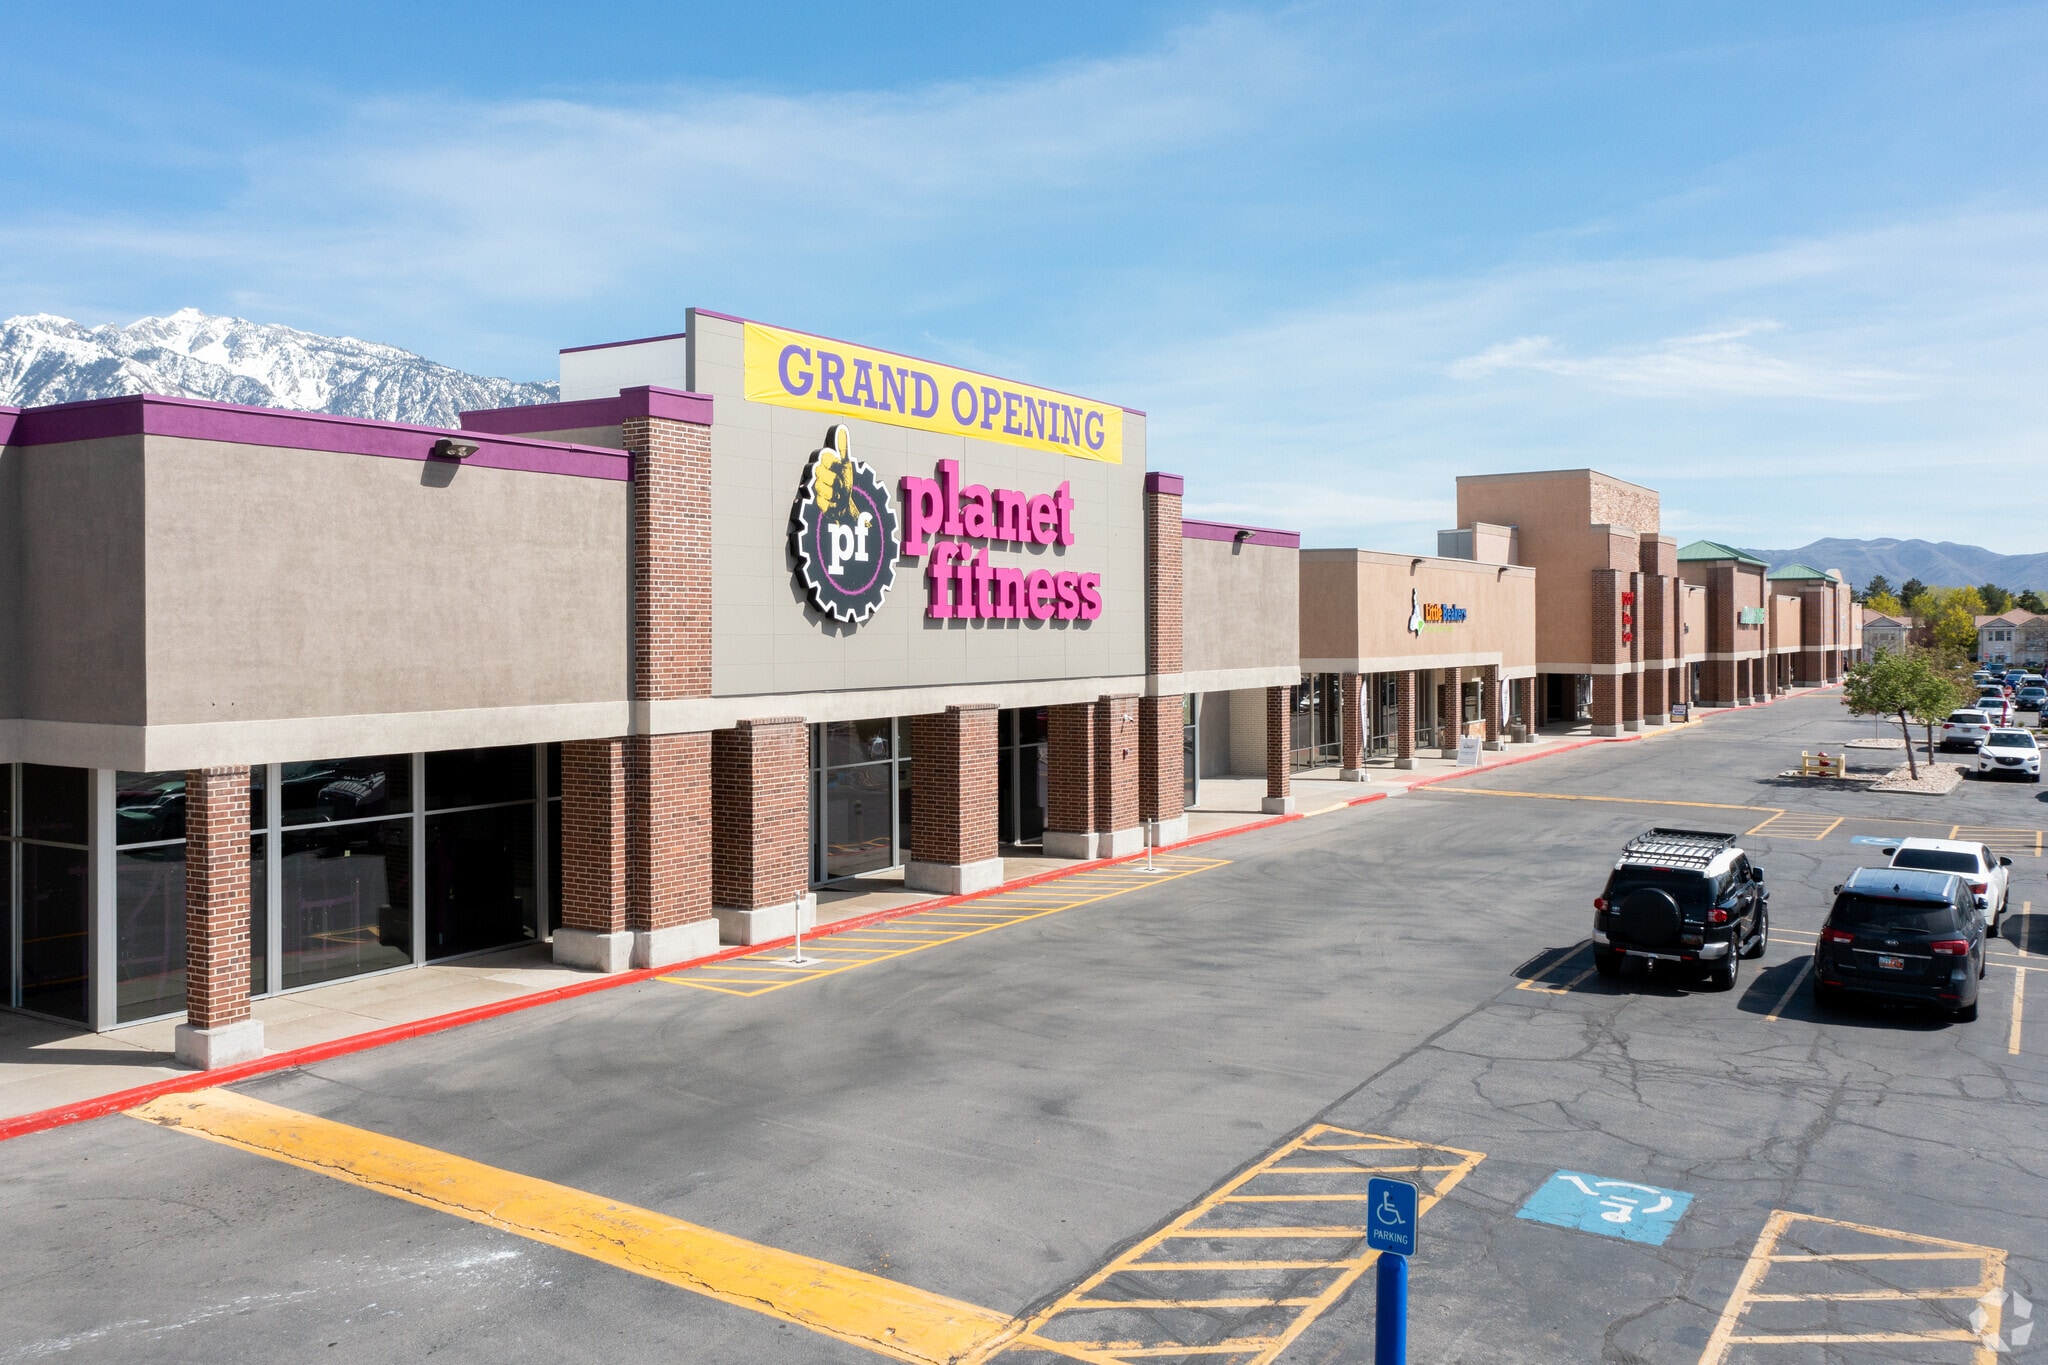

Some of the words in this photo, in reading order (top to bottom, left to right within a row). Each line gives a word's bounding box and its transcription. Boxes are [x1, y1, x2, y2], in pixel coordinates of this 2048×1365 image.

[778, 344, 939, 418] GRAND
[952, 381, 1104, 450] OPENING
[828, 512, 872, 575] pf
[901, 459, 1075, 556] planet
[927, 541, 1102, 621] fitness
[1373, 1229, 1408, 1245] PARKING
